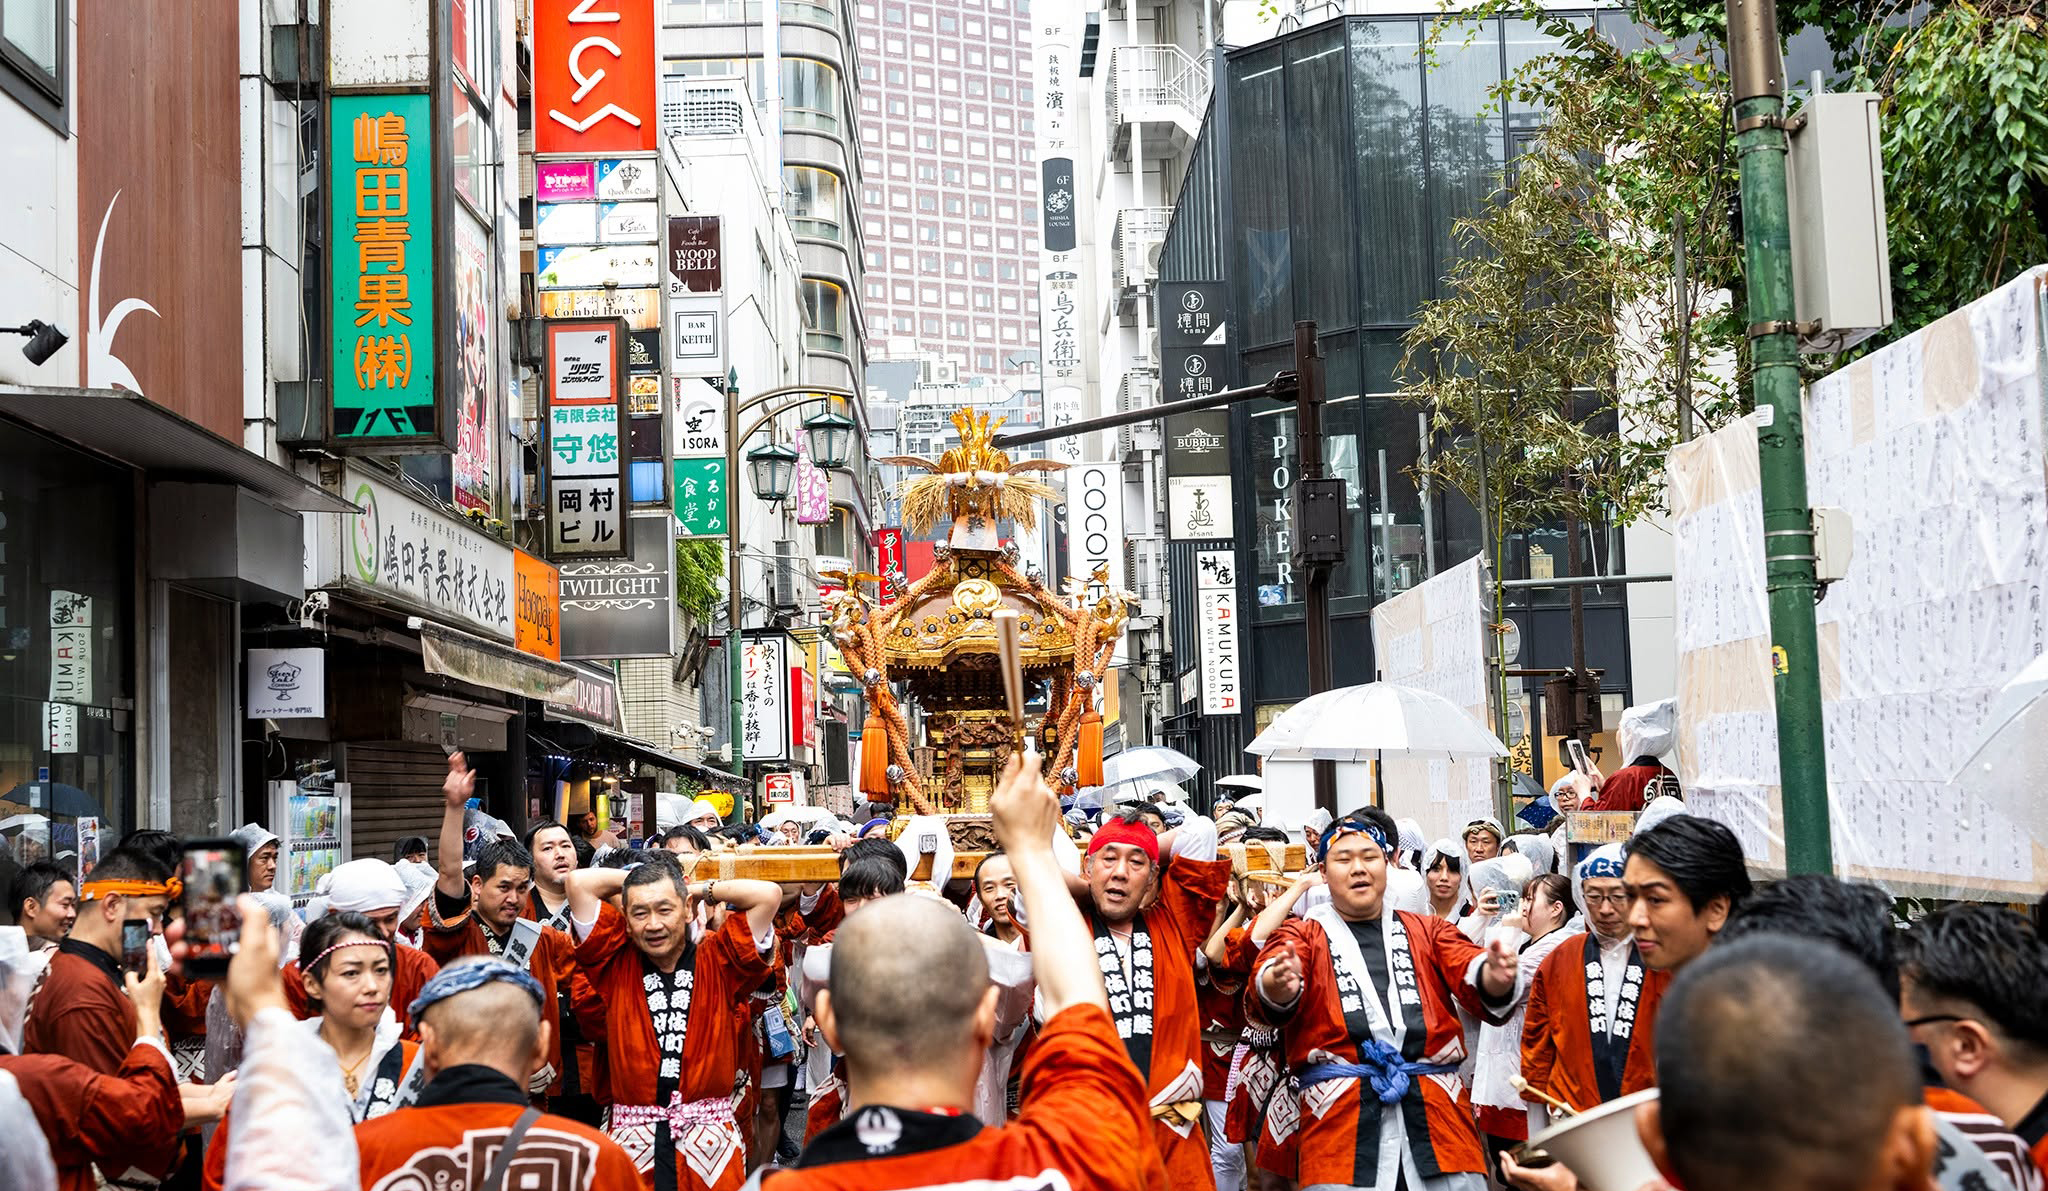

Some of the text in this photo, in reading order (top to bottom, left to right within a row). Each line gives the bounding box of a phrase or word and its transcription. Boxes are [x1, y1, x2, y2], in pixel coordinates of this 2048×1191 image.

[1057, 176, 1070, 185] 6F
[675, 249, 716, 259] WOOD
[676, 259, 716, 270] BELL
[671, 283, 683, 292] 5F
[604, 306, 644, 316] House
[595, 335, 607, 343] 4F
[682, 335, 712, 344] KEITH
[712, 378, 723, 387] 3F
[364, 408, 406, 434] 1F
[553, 408, 616, 424] 有限会社
[552, 433, 618, 464] 守悠
[683, 437, 718, 449] ISORA
[1177, 438, 1220, 448] BUBBLE
[558, 487, 615, 513] 岡村
[680, 477, 699, 522] 食堂
[704, 462, 720, 530] つるかめ
[1272, 436, 1294, 585] POKER
[560, 519, 615, 543] ビル
[383, 525, 509, 627] 嶋田青果株式会社
[560, 577, 660, 597] TWILIGHT
[1205, 595, 1213, 622] SOUP
[1209, 660, 1217, 709] NOODLES
[1217, 593, 1235, 709] KAMUKURA
[761, 644, 775, 706] 炊きたての
